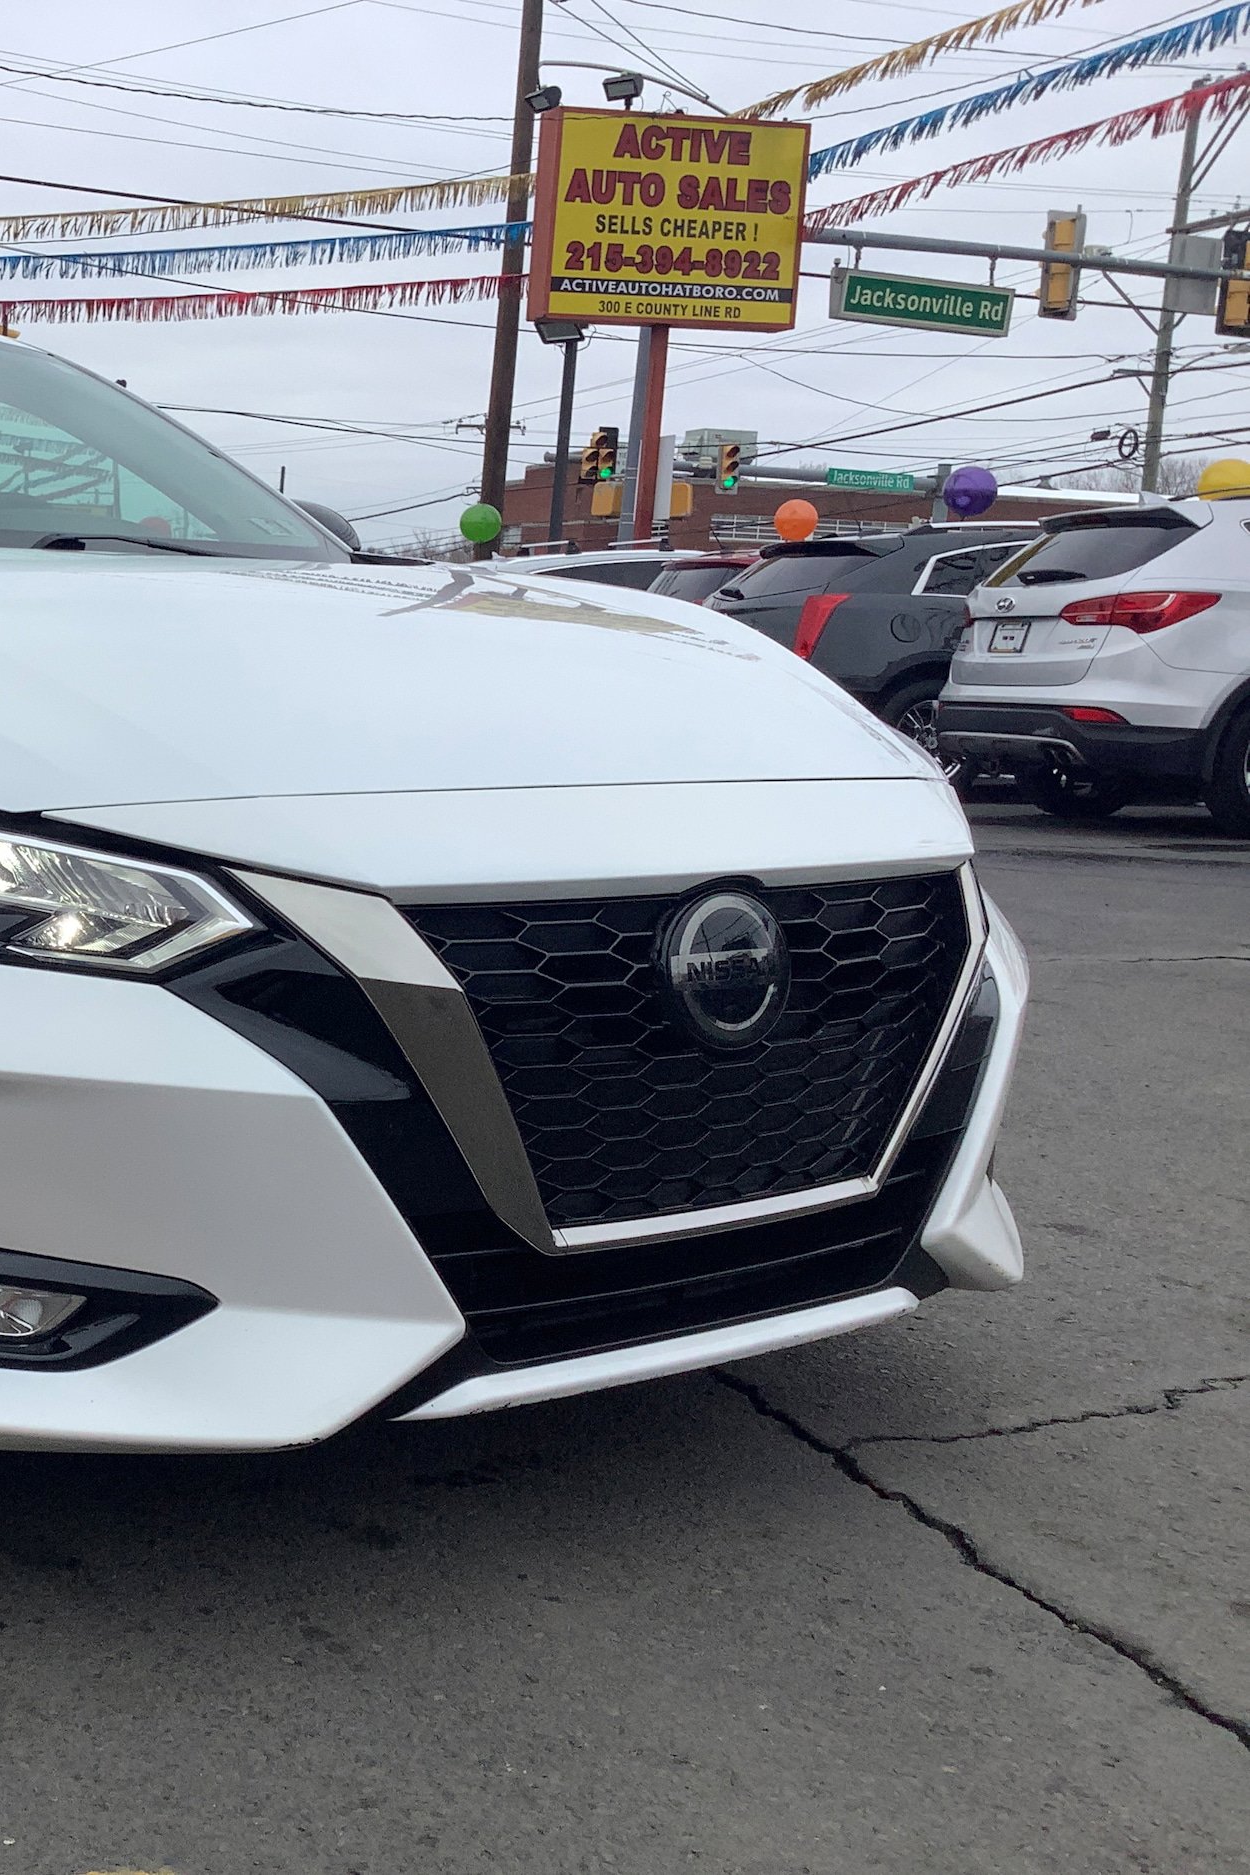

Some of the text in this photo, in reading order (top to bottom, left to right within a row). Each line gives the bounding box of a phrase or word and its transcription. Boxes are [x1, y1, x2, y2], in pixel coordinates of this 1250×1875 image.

[613, 123, 752, 166] ACTIVE
[564, 168, 791, 215] AUTO SALES
[595, 214, 653, 236] SELLS
[659, 220, 747, 242] CHEAPER
[564, 240, 781, 281] 215-394-8922
[560, 279, 780, 301] ACTIVEAUTOHATBORO.COM
[850, 285, 1004, 321] Jacksonville Rd
[598, 300, 741, 319] 300 E COUNTY LINE RD
[833, 470, 910, 488] Jacksonville Rd
[687, 956, 767, 983] NISSA
